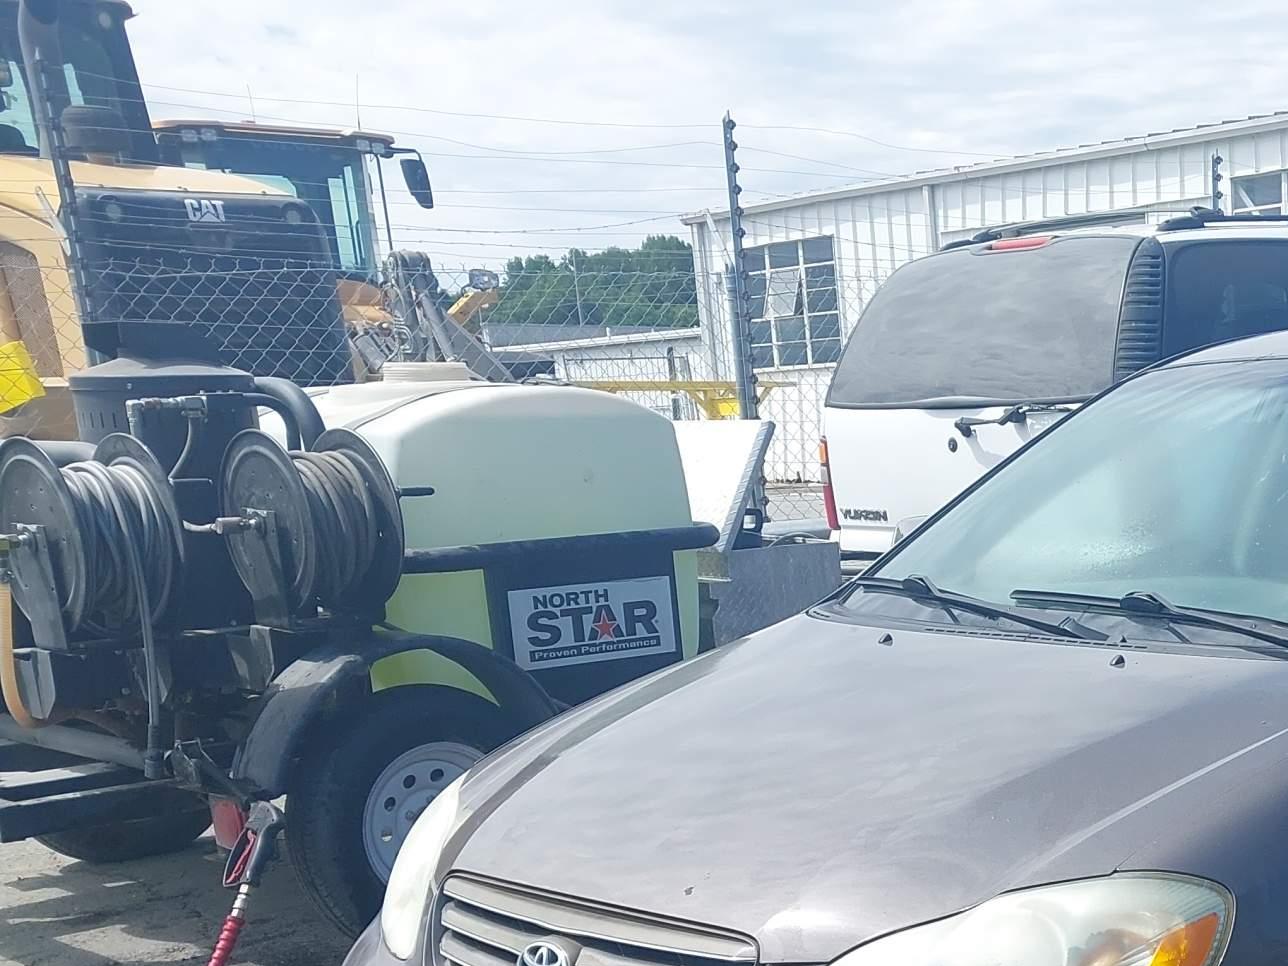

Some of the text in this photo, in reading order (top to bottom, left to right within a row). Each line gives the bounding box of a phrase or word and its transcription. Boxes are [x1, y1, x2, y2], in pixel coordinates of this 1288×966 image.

[184, 198, 226, 222] CAT
[840, 508, 889, 522] YUKON
[532, 588, 610, 610] NORTH
[526, 600, 661, 648] STAR
[534, 638, 658, 660] Proven Performance
